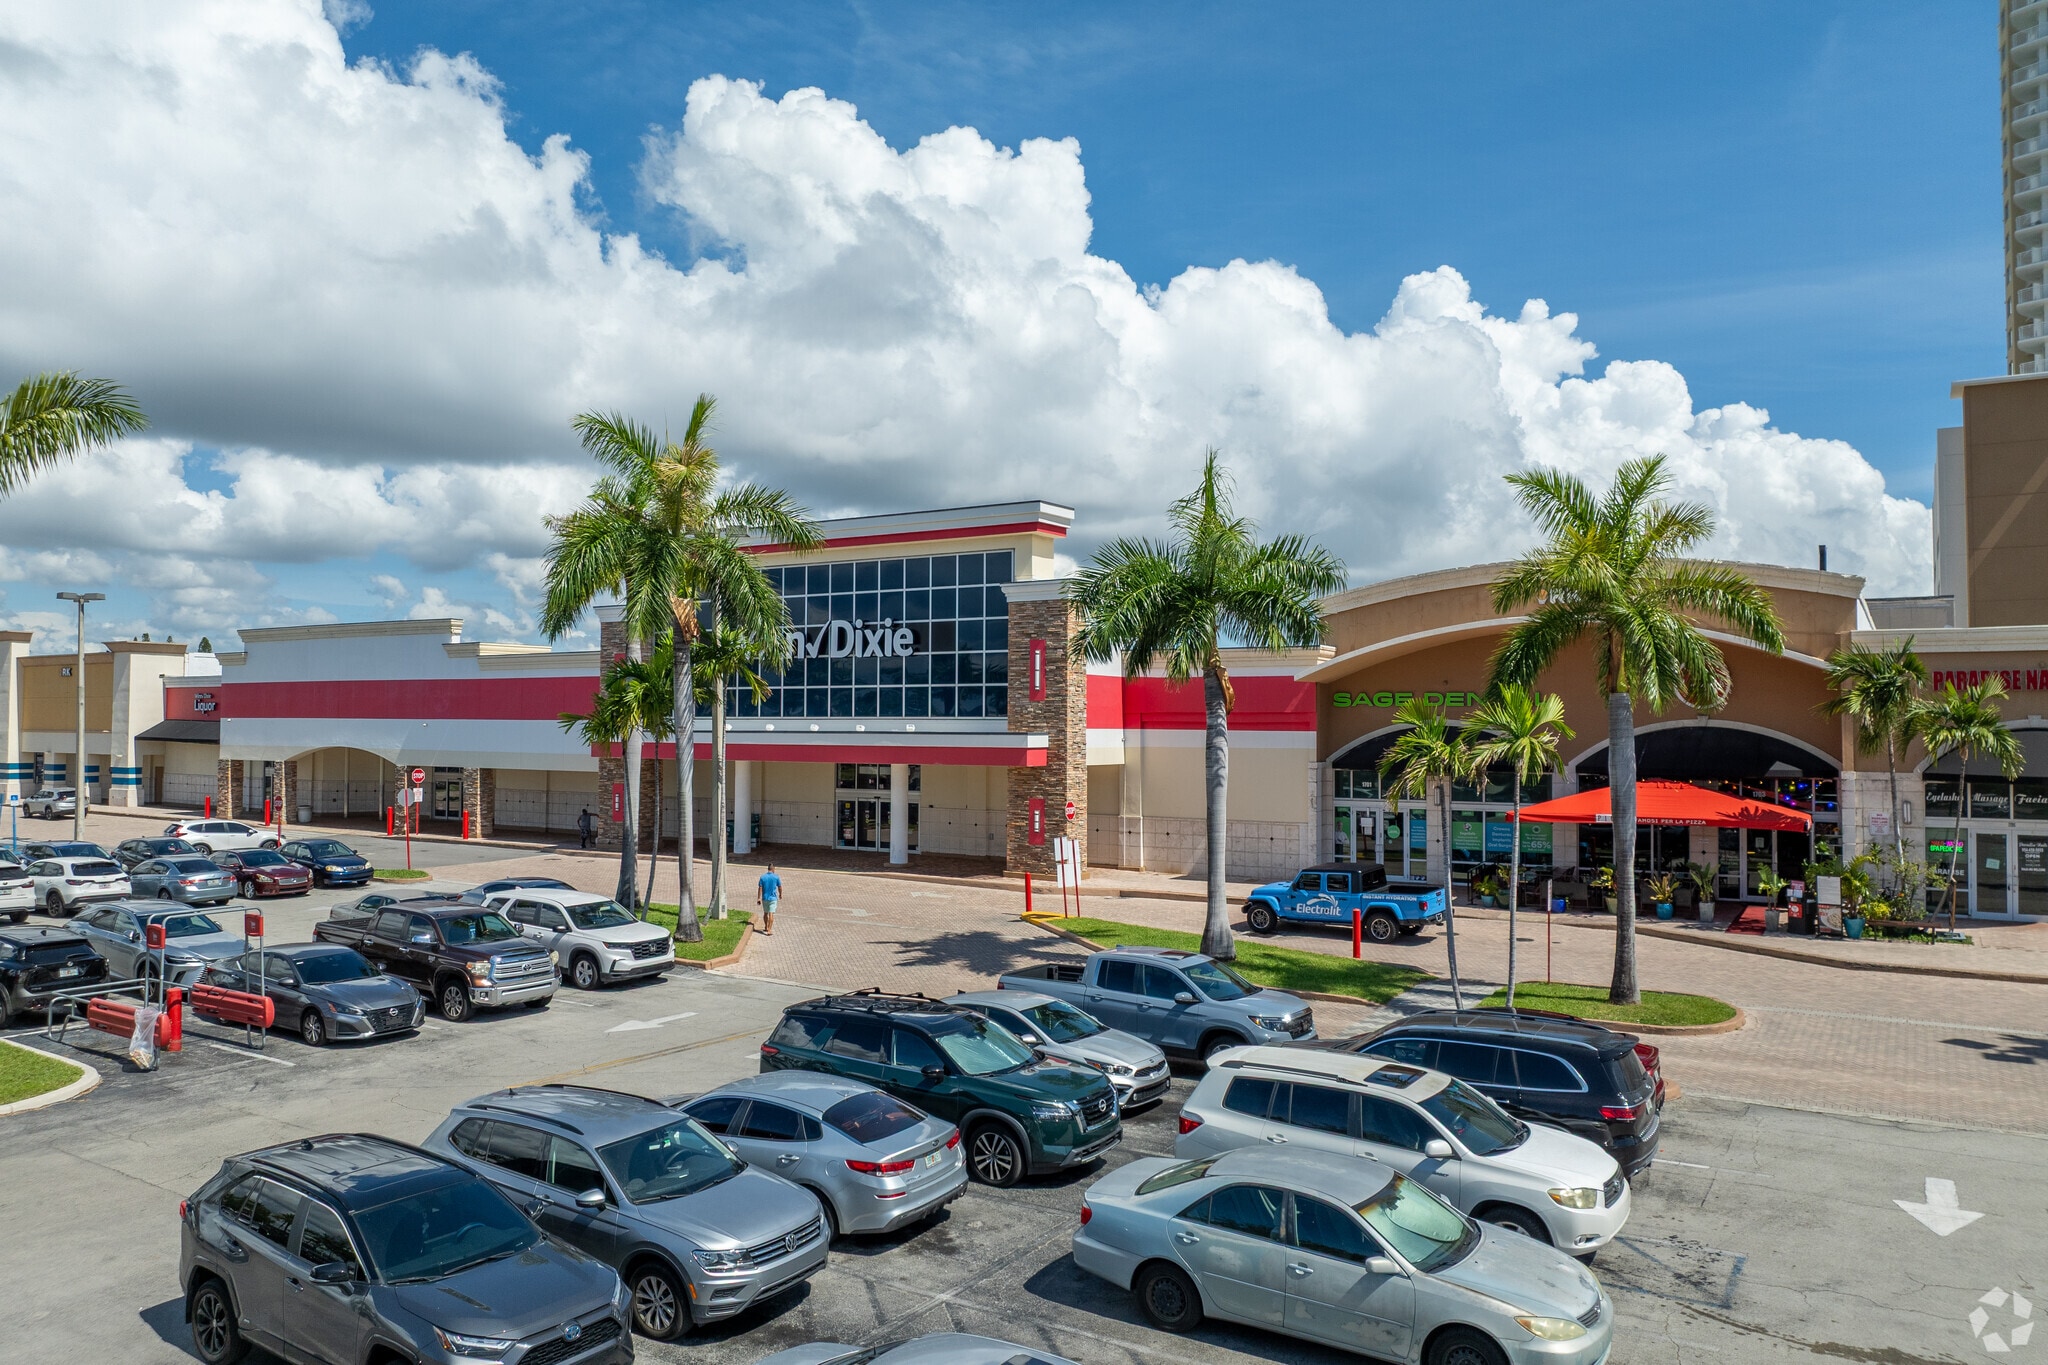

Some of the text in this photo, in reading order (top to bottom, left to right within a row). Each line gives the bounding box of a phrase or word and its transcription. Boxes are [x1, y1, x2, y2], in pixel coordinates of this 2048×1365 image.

[830, 617, 914, 658] Dixie
[1933, 670, 2021, 691] PARASE
[194, 699, 216, 715] Liquor
[1333, 692, 1546, 708] SAGE DENL
[1971, 793, 2009, 806] Massage
[1531, 840, 1551, 849] 65%
[1385, 894, 1417, 902] HYDRATION
[1296, 903, 1341, 916] Electrolit
